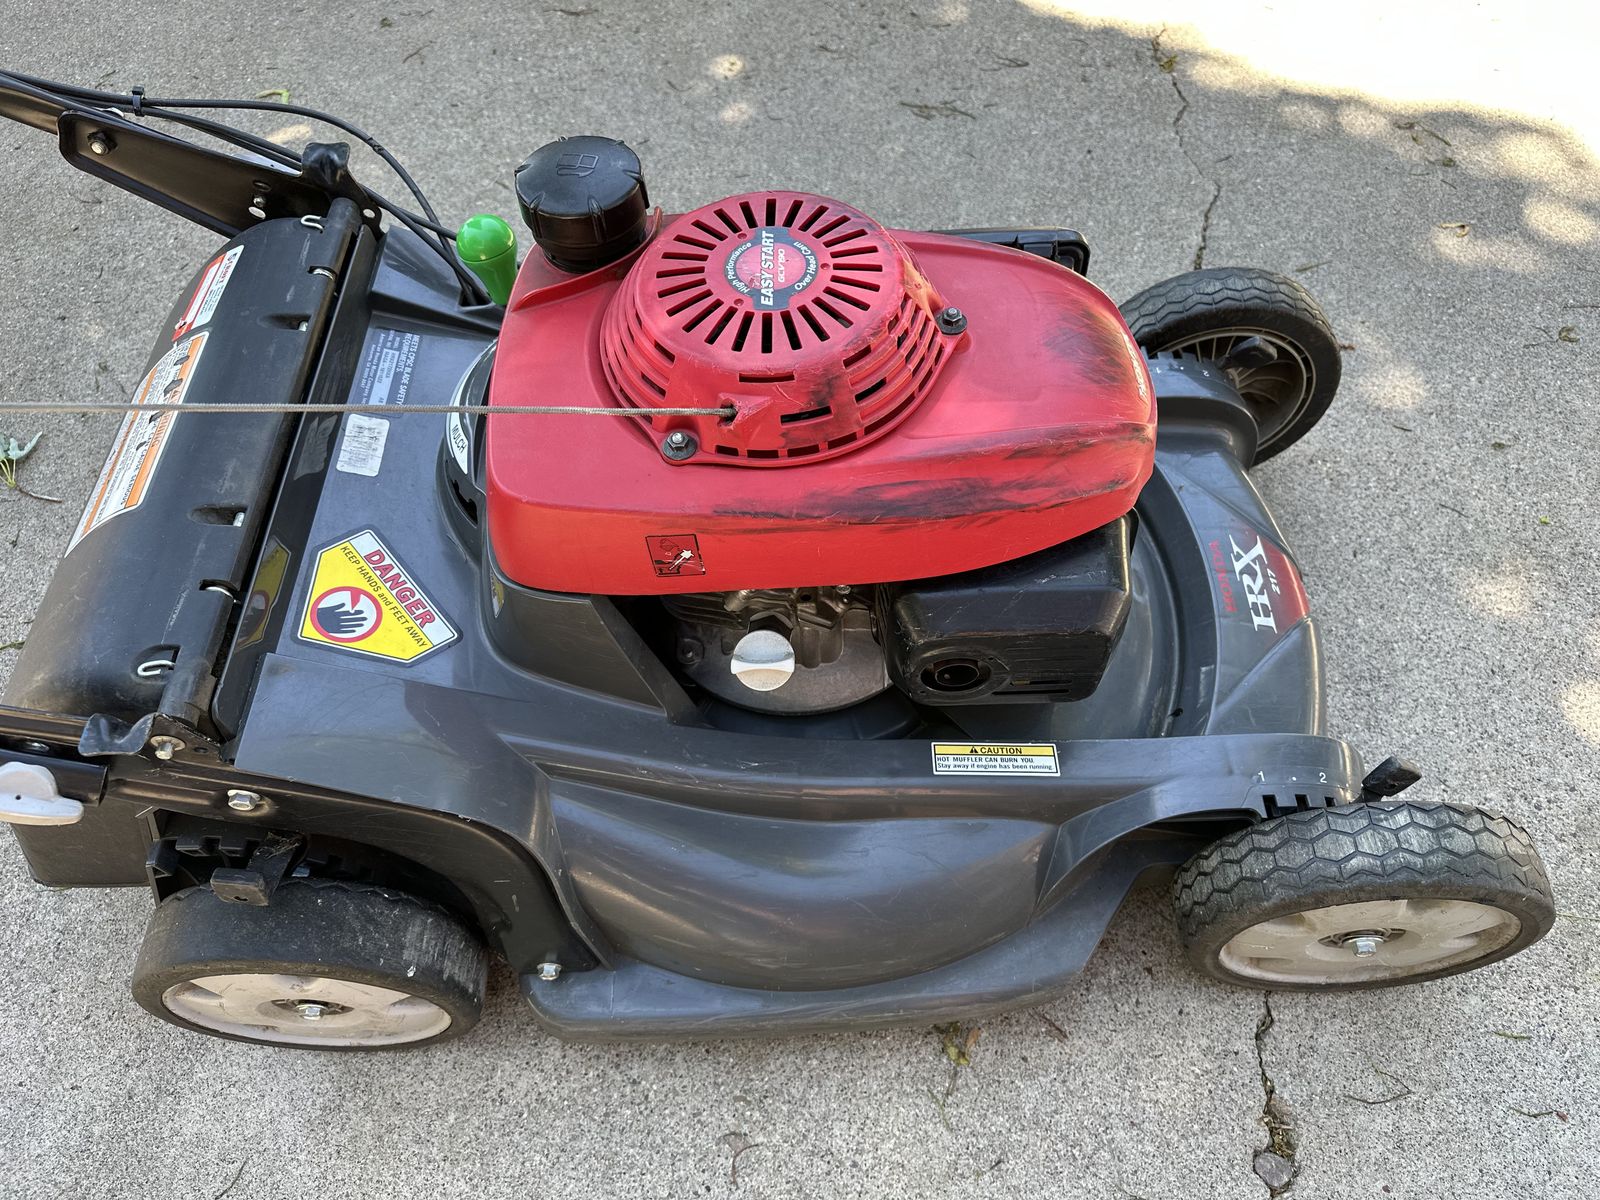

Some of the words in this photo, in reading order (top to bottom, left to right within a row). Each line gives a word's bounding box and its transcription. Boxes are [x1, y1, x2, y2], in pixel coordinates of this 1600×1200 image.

[762, 231, 774, 269] START
[794, 242, 811, 255] Cam
[726, 242, 752, 279] Performance
[807, 256, 816, 274] Head
[732, 280, 750, 293] High
[760, 269, 774, 306] EASY
[795, 274, 812, 290] Over
[410, 334, 420, 351] MEETS
[402, 367, 412, 384] BLADE
[396, 385, 407, 405] SAFETY
[452, 424, 467, 453] MULCH
[364, 548, 436, 629] DANGER
[1229, 534, 1278, 634] HRX
[1267, 568, 1281, 595] 217
[340, 546, 360, 566] KEEP
[357, 566, 382, 593] HANDS
[378, 593, 392, 606] and
[390, 606, 409, 625] FEET
[405, 626, 428, 648] AWAY
[980, 746, 1022, 754] CAUTION
[1258, 771, 1265, 781] 1
[1319, 772, 1327, 783] 2
